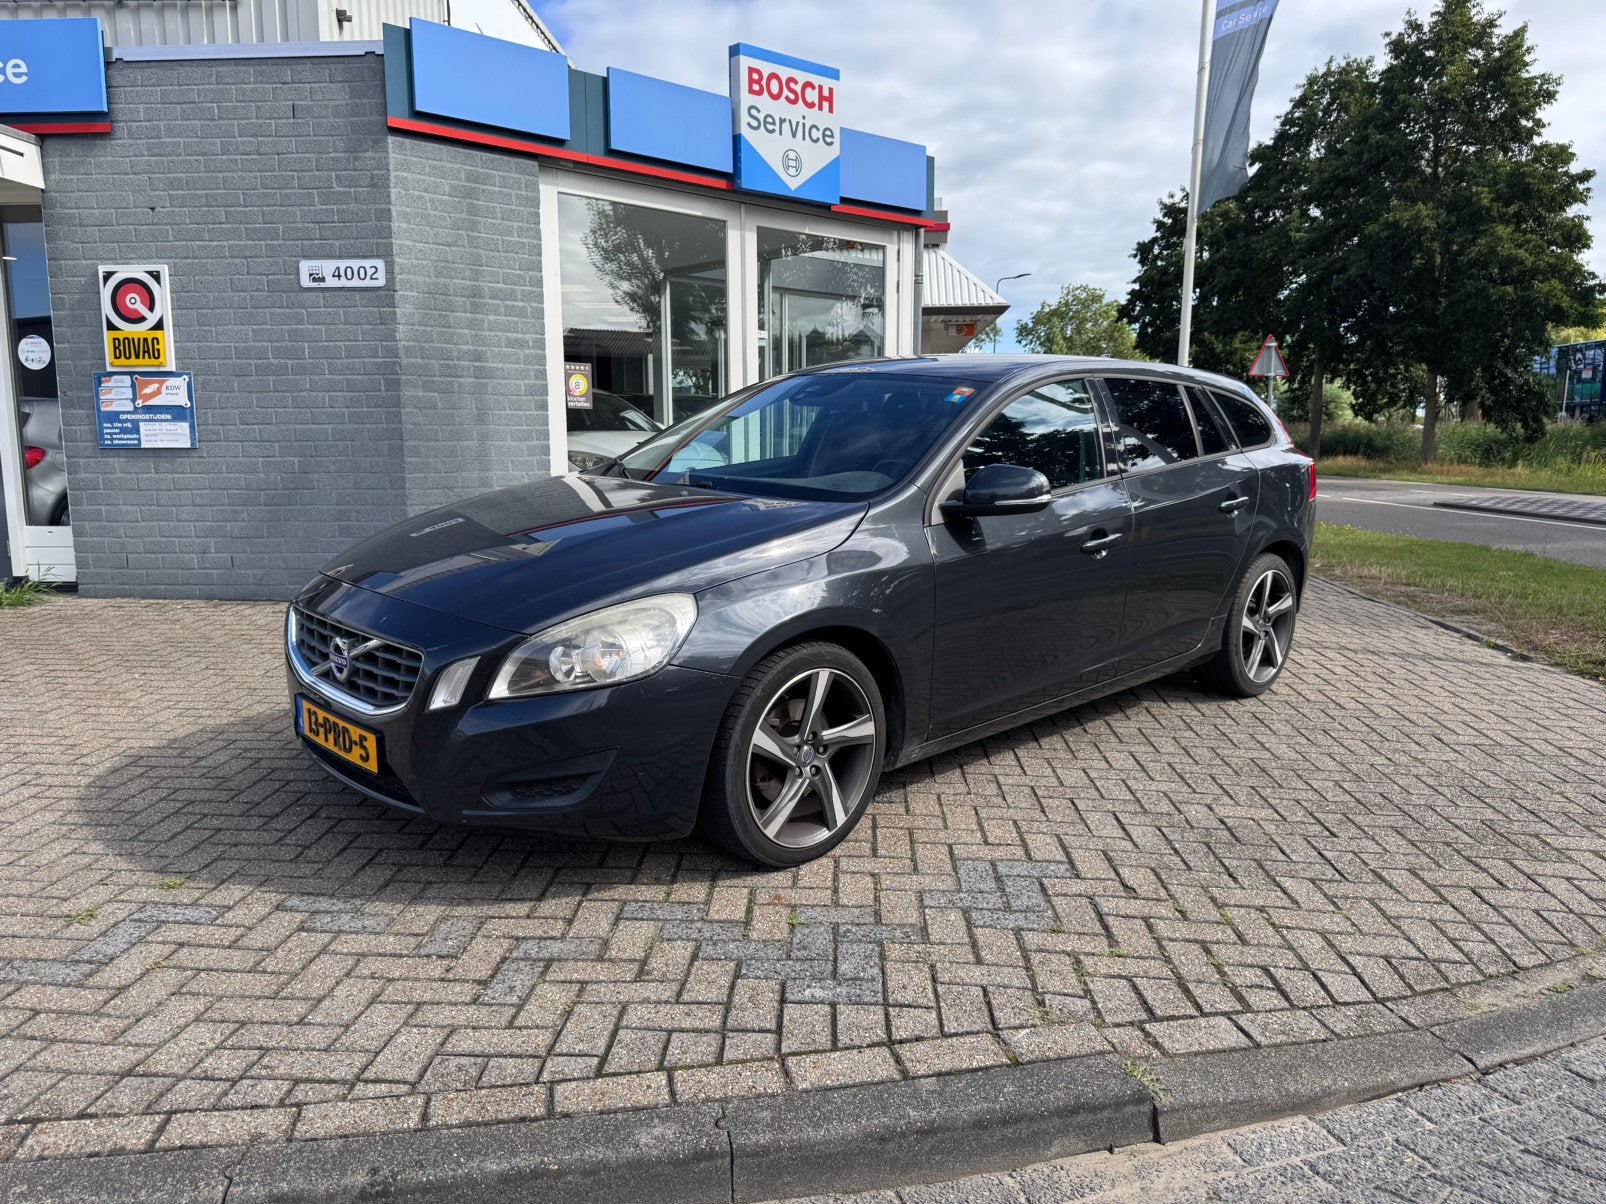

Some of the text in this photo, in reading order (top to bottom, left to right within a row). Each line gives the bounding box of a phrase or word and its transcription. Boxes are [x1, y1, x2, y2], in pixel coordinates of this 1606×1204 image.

[1221, 4, 1268, 31] Car Sevie
[0, 58, 29, 84] e
[747, 66, 834, 114] BOSCH
[747, 104, 835, 147] Service
[331, 265, 379, 281] 4002
[112, 337, 161, 360] BOVAG
[306, 707, 370, 763] 13-PRD-5
